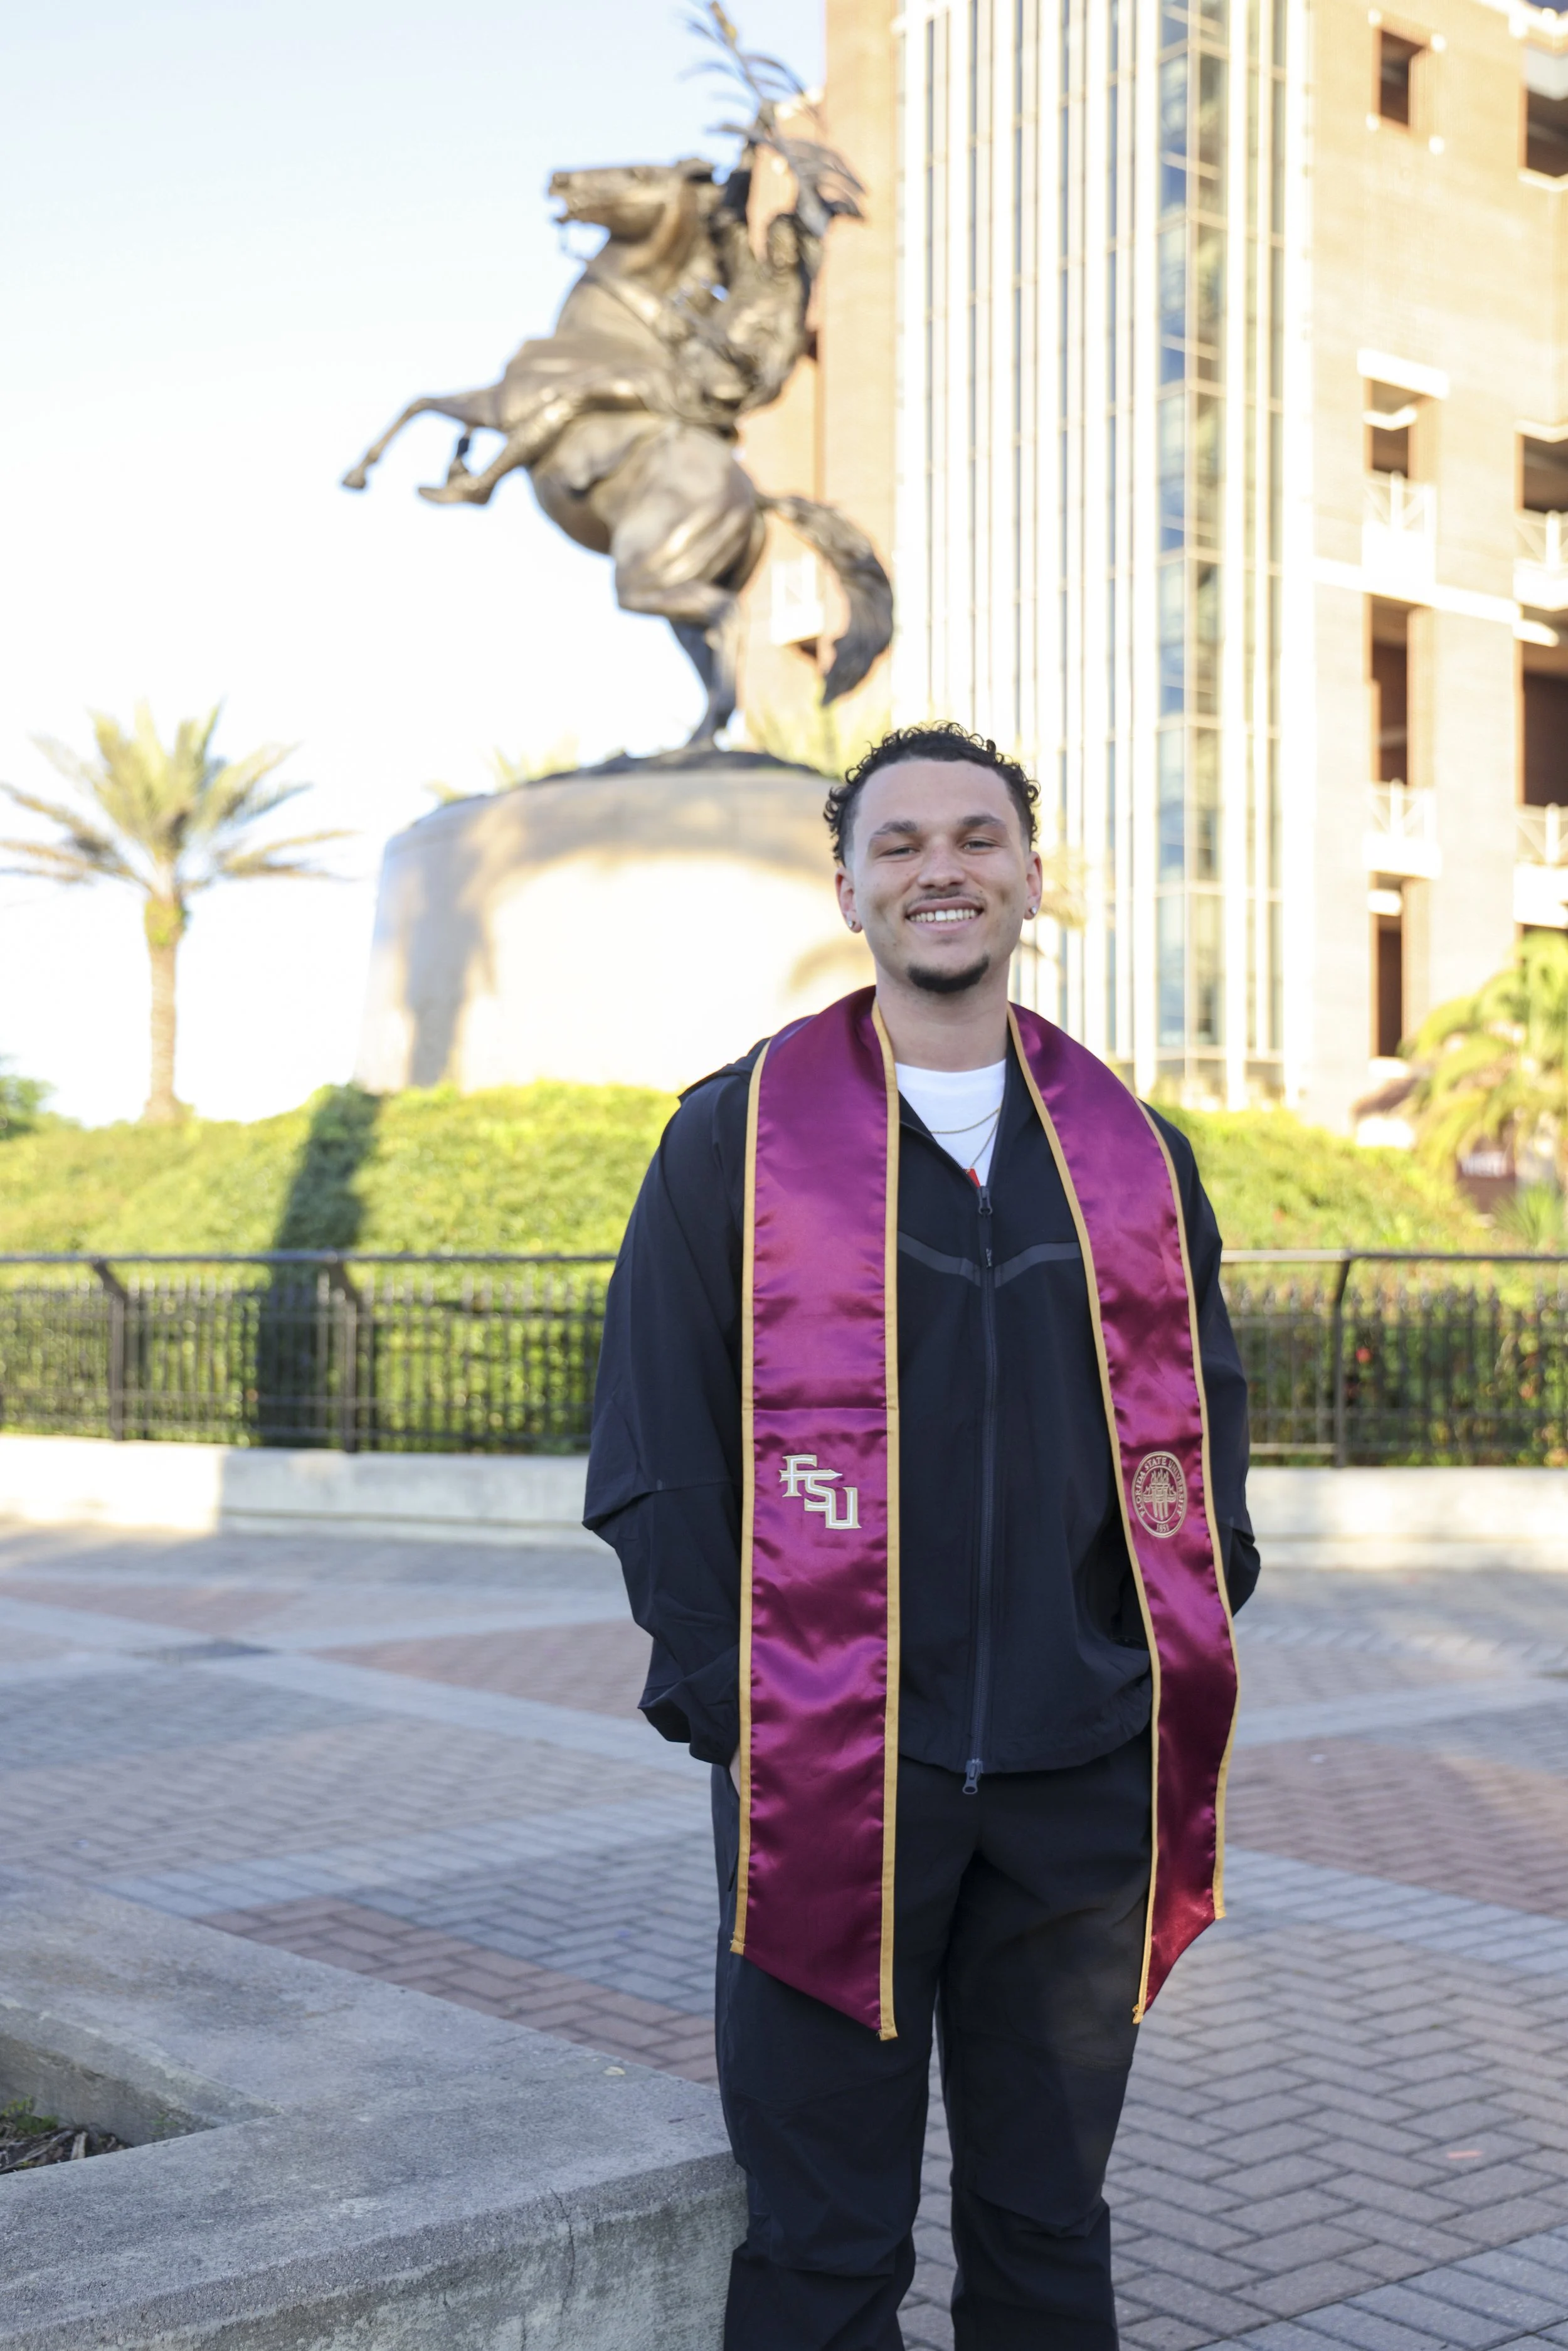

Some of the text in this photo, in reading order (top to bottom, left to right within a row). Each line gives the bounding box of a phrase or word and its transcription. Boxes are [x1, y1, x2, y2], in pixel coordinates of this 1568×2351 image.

[778, 1454, 862, 1530] FSU
[1135, 1457, 1184, 1517] FLORIDA STATE UNIVERSITY
